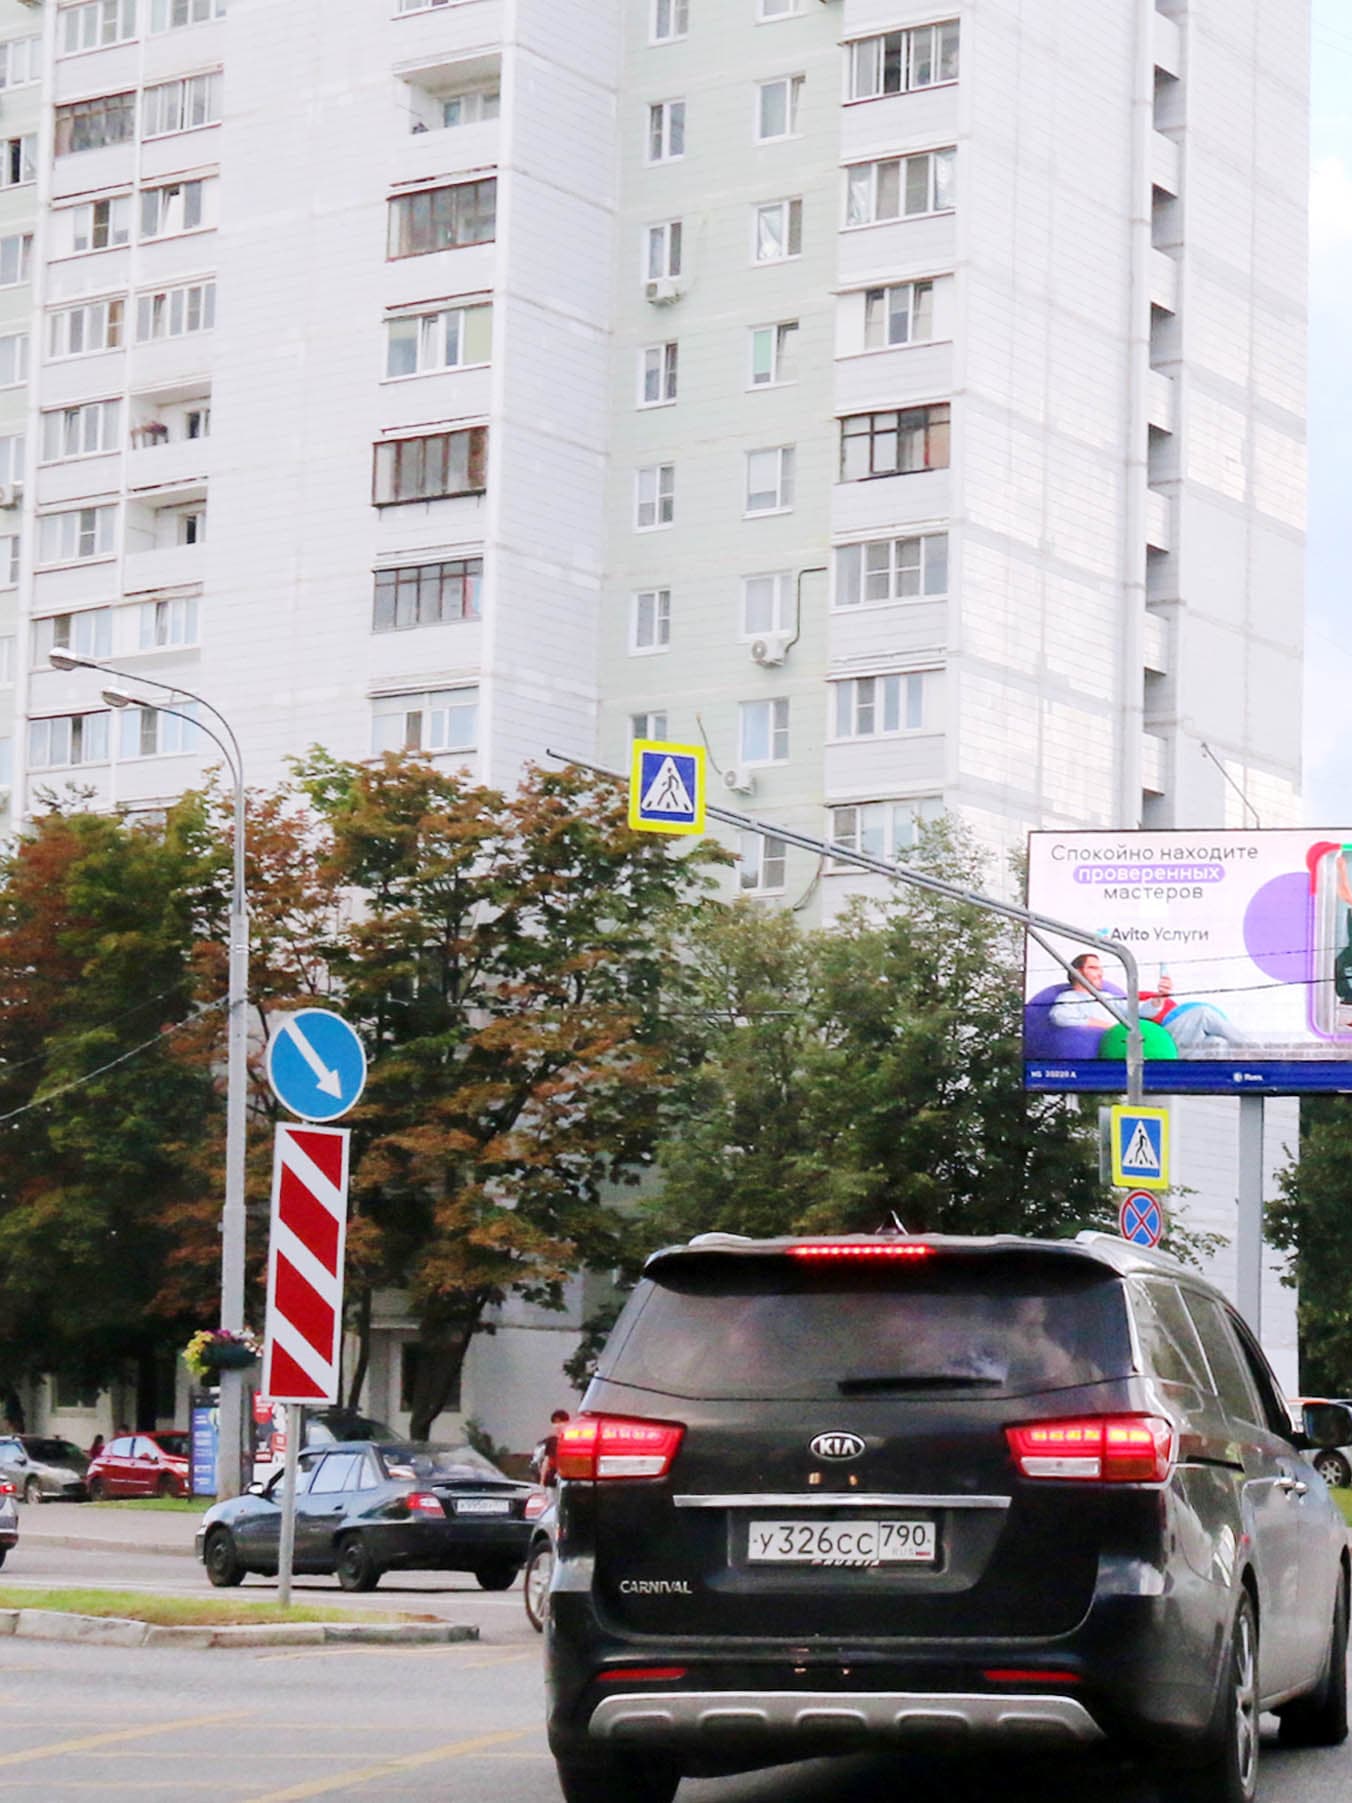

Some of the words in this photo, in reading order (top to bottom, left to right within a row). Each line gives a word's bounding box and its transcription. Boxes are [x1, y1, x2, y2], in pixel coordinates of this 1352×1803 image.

[1050, 844, 1154, 861] Спокойно
[1159, 846, 1259, 862] находите
[1078, 866, 1221, 884] проверенных
[1103, 886, 1204, 904] мастеров
[1110, 926, 1150, 942] Avito
[1152, 926, 1209, 944] Услуги
[819, 1438, 857, 1456] KIA
[880, 1524, 926, 1547] 790
[619, 1580, 693, 1595] CARNIVAL
